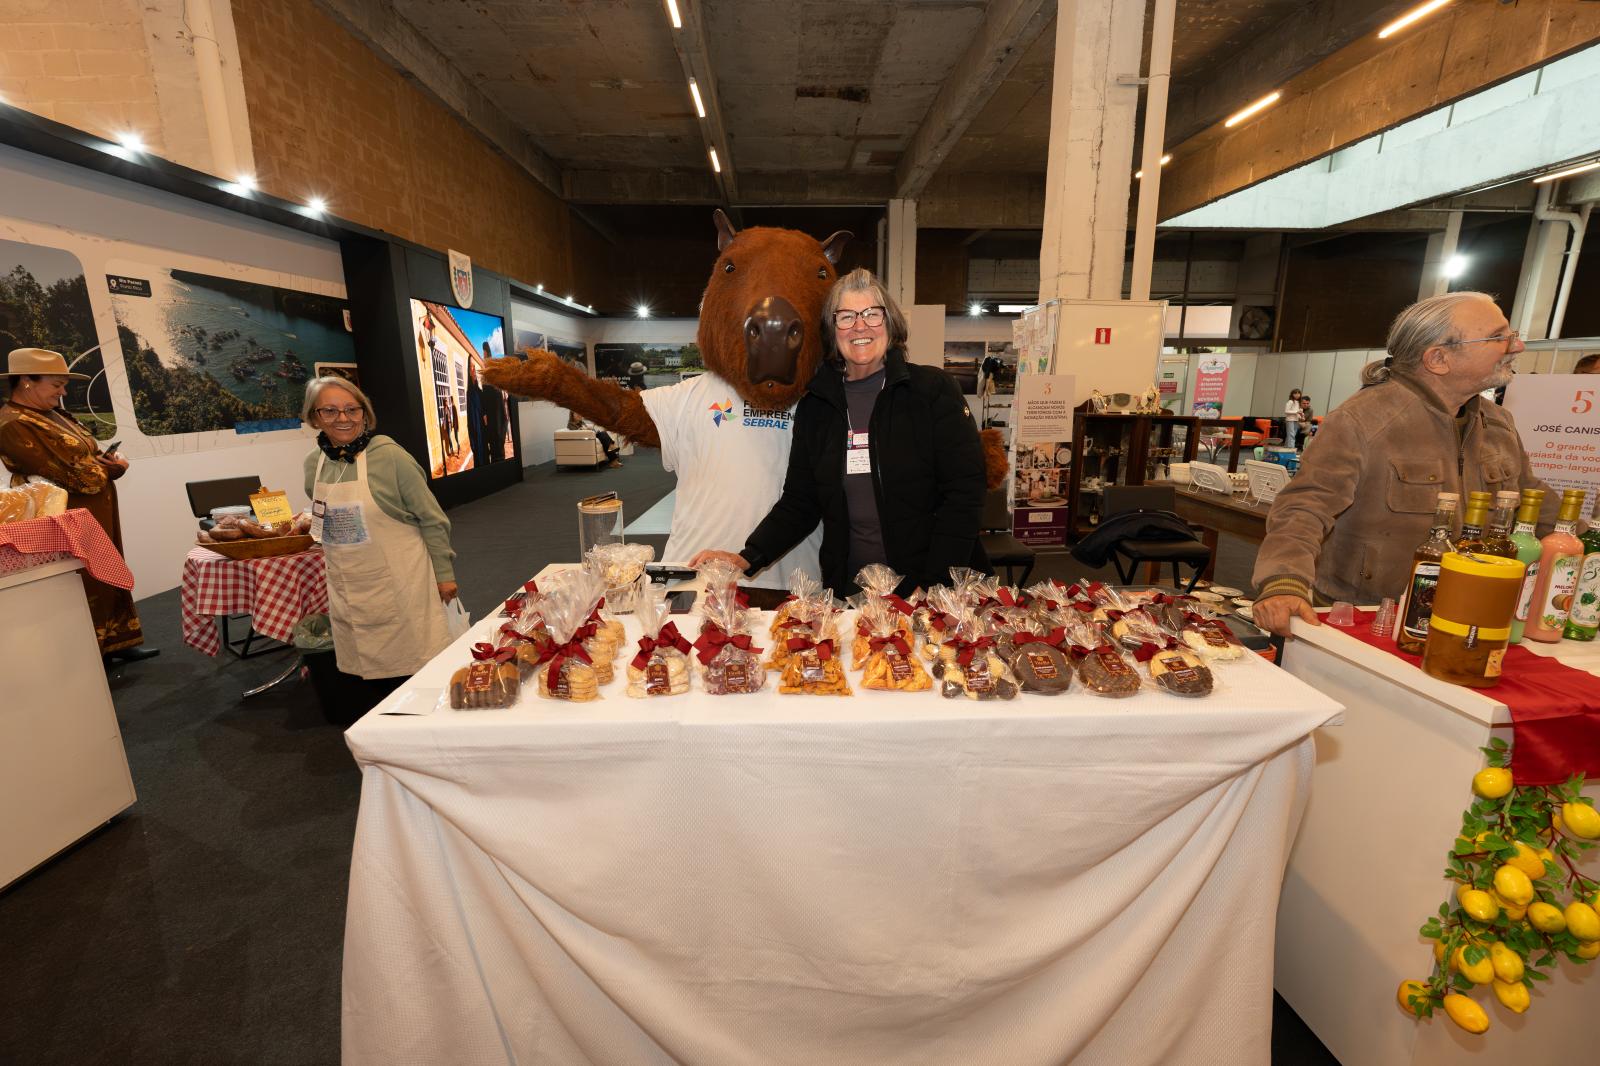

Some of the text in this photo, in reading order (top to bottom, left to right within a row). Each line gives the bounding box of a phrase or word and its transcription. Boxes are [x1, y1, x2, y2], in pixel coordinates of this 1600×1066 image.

[1571, 390, 1595, 413] 5
[742, 418, 789, 430] SEBRAE
[1533, 424, 1562, 433] JOSÉ
[1545, 441, 1596, 452] O grande
[1565, 453, 1578, 461] da
